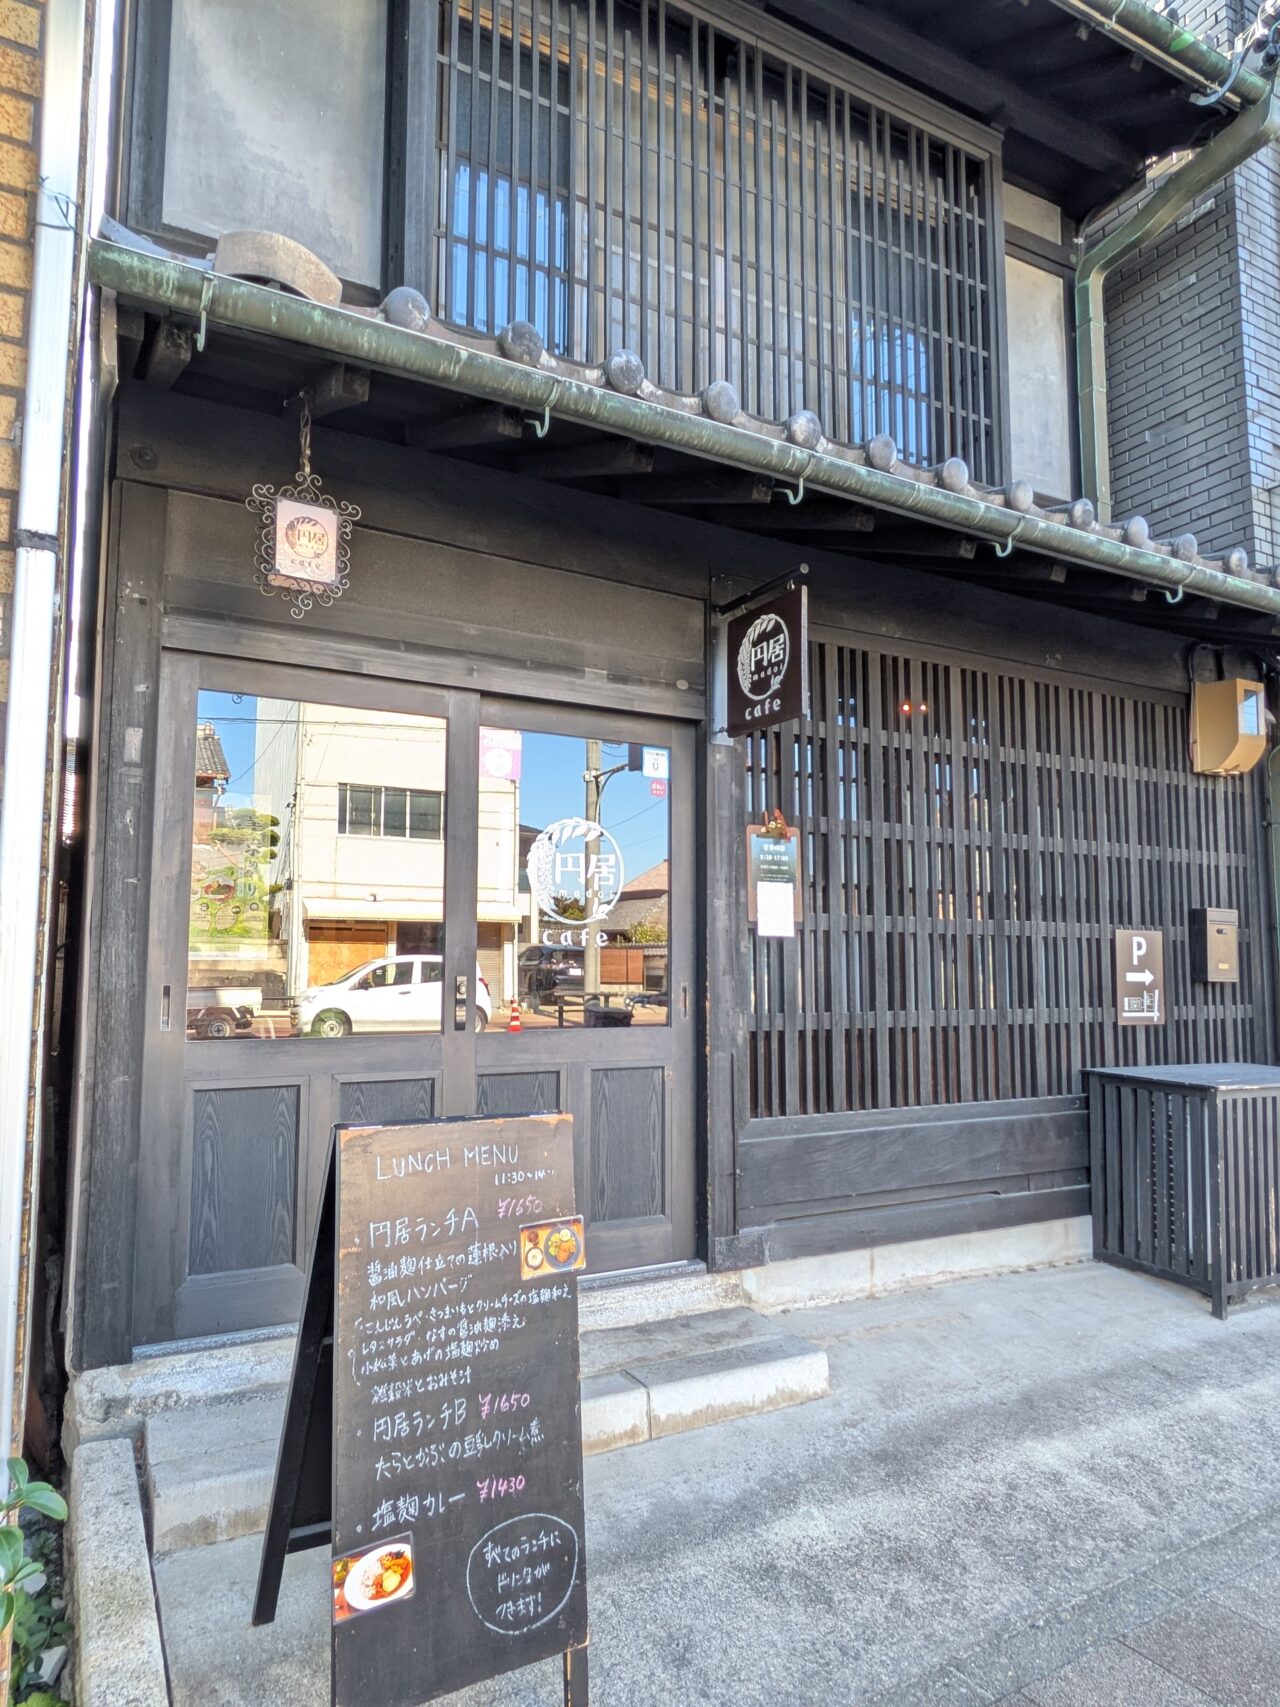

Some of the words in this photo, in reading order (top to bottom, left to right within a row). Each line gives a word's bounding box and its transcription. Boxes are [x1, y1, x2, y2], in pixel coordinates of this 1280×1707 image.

[751, 633, 785, 672] 円居
[745, 698, 782, 721] cafe
[555, 852, 617, 891] 円居
[542, 928, 609, 948] cafe
[1132, 936, 1148, 965] P
[376, 1147, 450, 1181] LUNCH
[463, 1144, 519, 1169] MENU
[498, 1194, 543, 1219] ¥1650
[369, 1206, 479, 1249] 円居ランチA
[369, 1274, 473, 1312] 和風ハンバーグ
[373, 1398, 467, 1441] 円居ランチB
[478, 1393, 531, 1419] ¥1650
[374, 1416, 545, 1481] たらとかぶの豆乳クリーム煮
[476, 1474, 526, 1504] ¥1430
[371, 1492, 465, 1532] 塩麹カレー
[483, 1529, 562, 1568] すべてのランチに
[497, 1562, 550, 1594] ドリンクが
